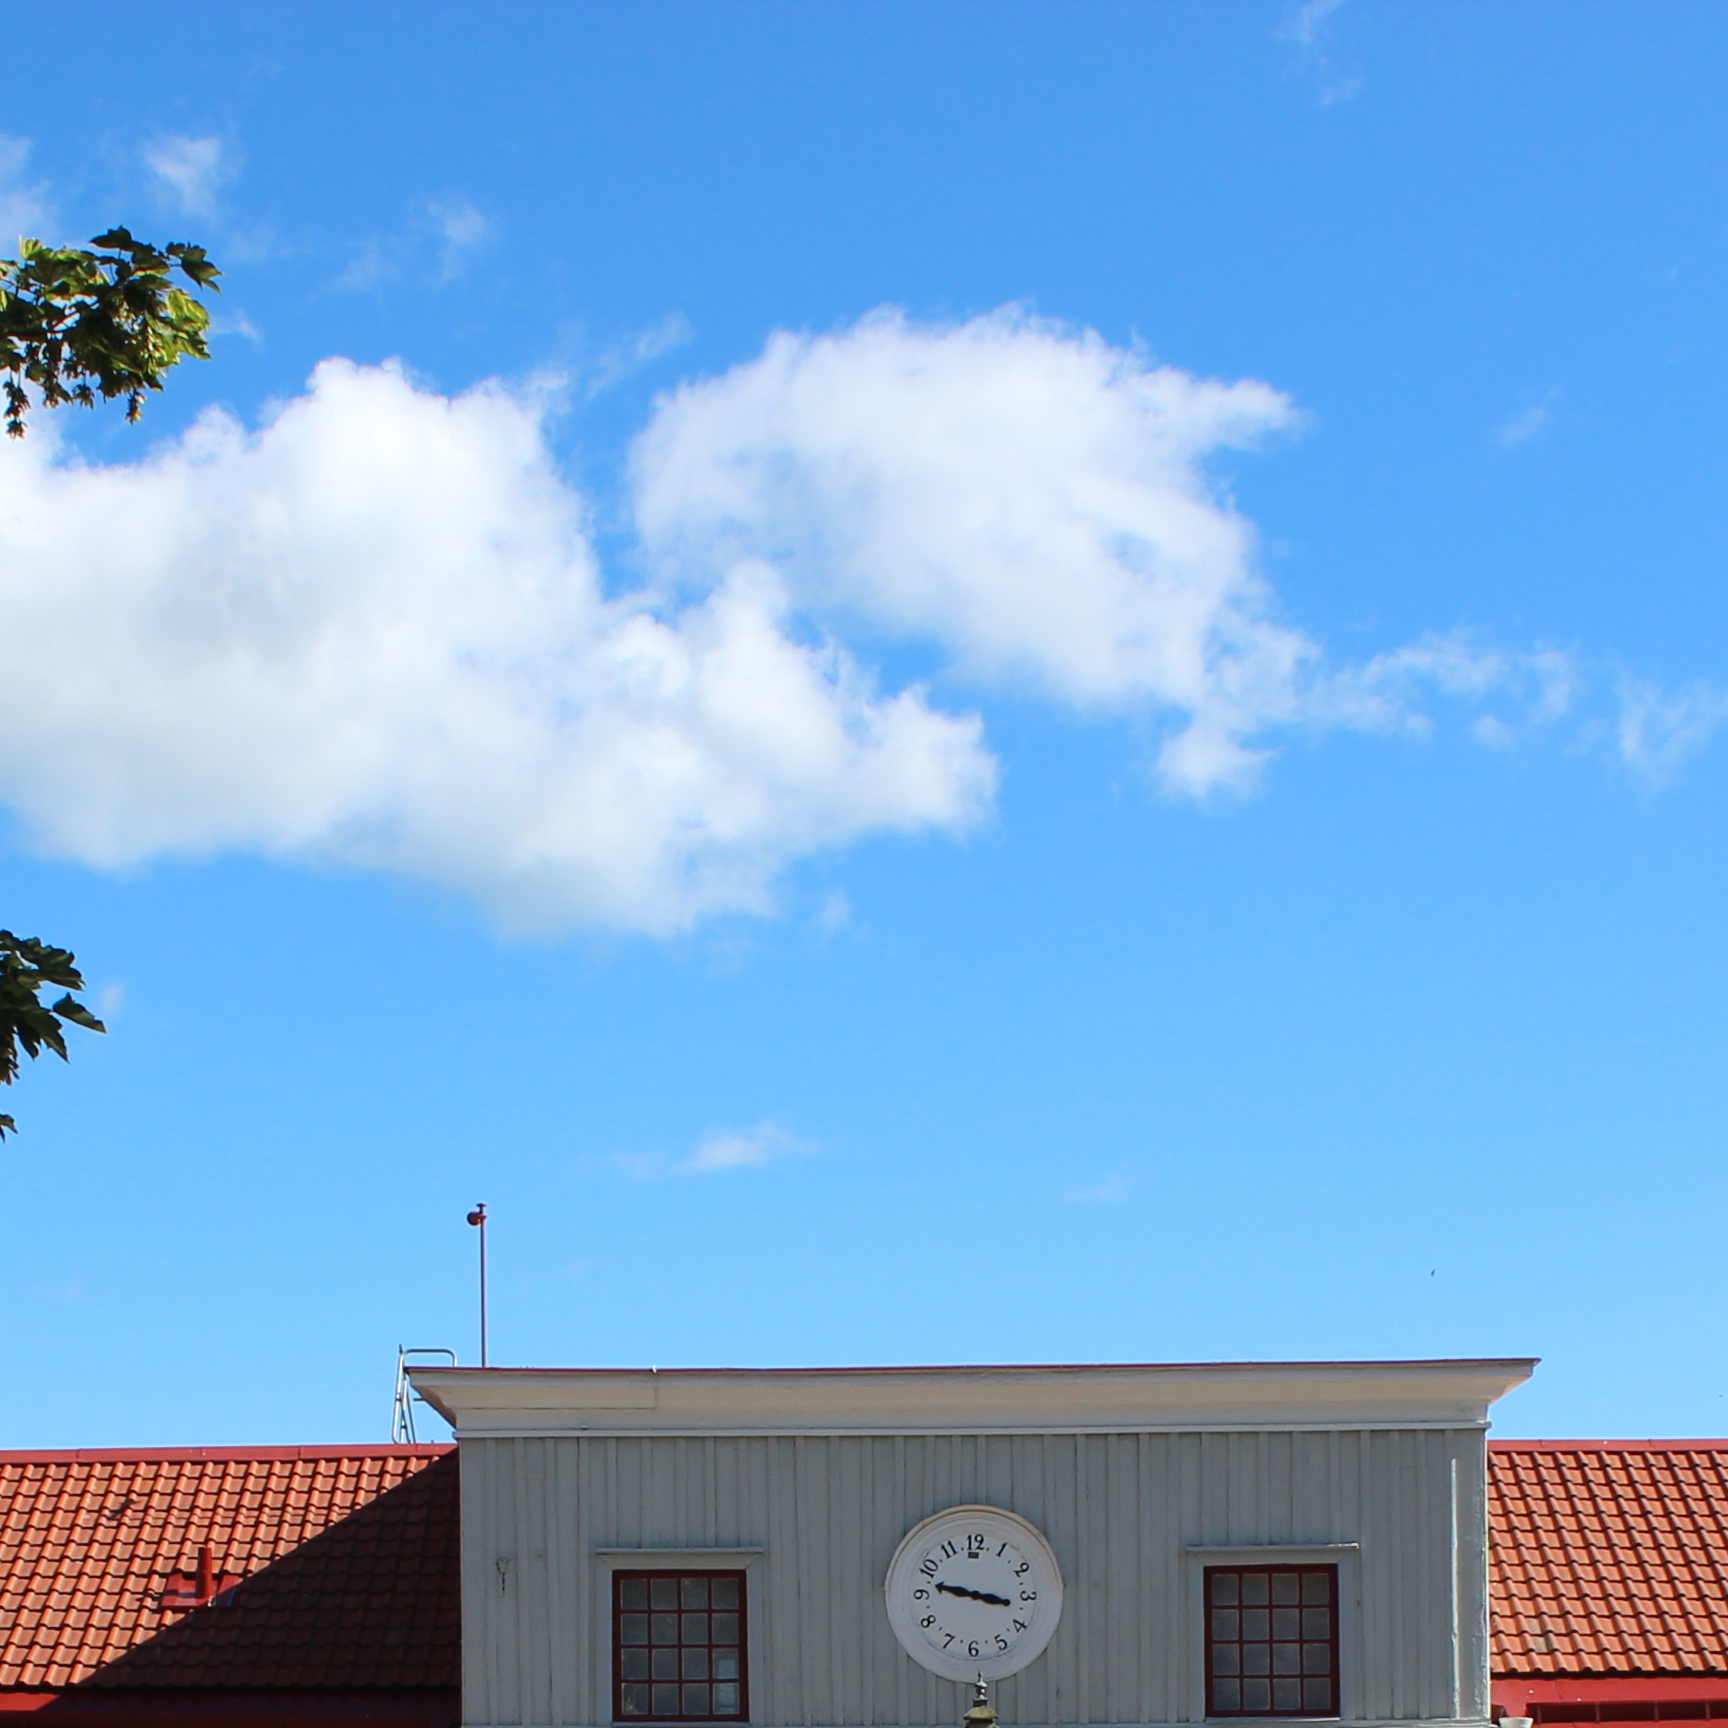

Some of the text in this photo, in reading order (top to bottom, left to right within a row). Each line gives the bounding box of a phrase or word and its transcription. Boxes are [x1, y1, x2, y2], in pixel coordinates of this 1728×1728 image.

[940, 1540, 958, 1559] 11
[966, 1533, 985, 1551] 12
[995, 1542, 1008, 1558] 1
[919, 1558, 939, 1579] 10
[1013, 1562, 1030, 1578] 2
[913, 1588, 930, 1601] 9
[1019, 1590, 1037, 1602] 3
[920, 1614, 937, 1628] 8
[1012, 1618, 1028, 1633] 4
[942, 1633, 956, 1649] 7
[967, 1640, 980, 1657] 6
[994, 1633, 1008, 1651] 5
